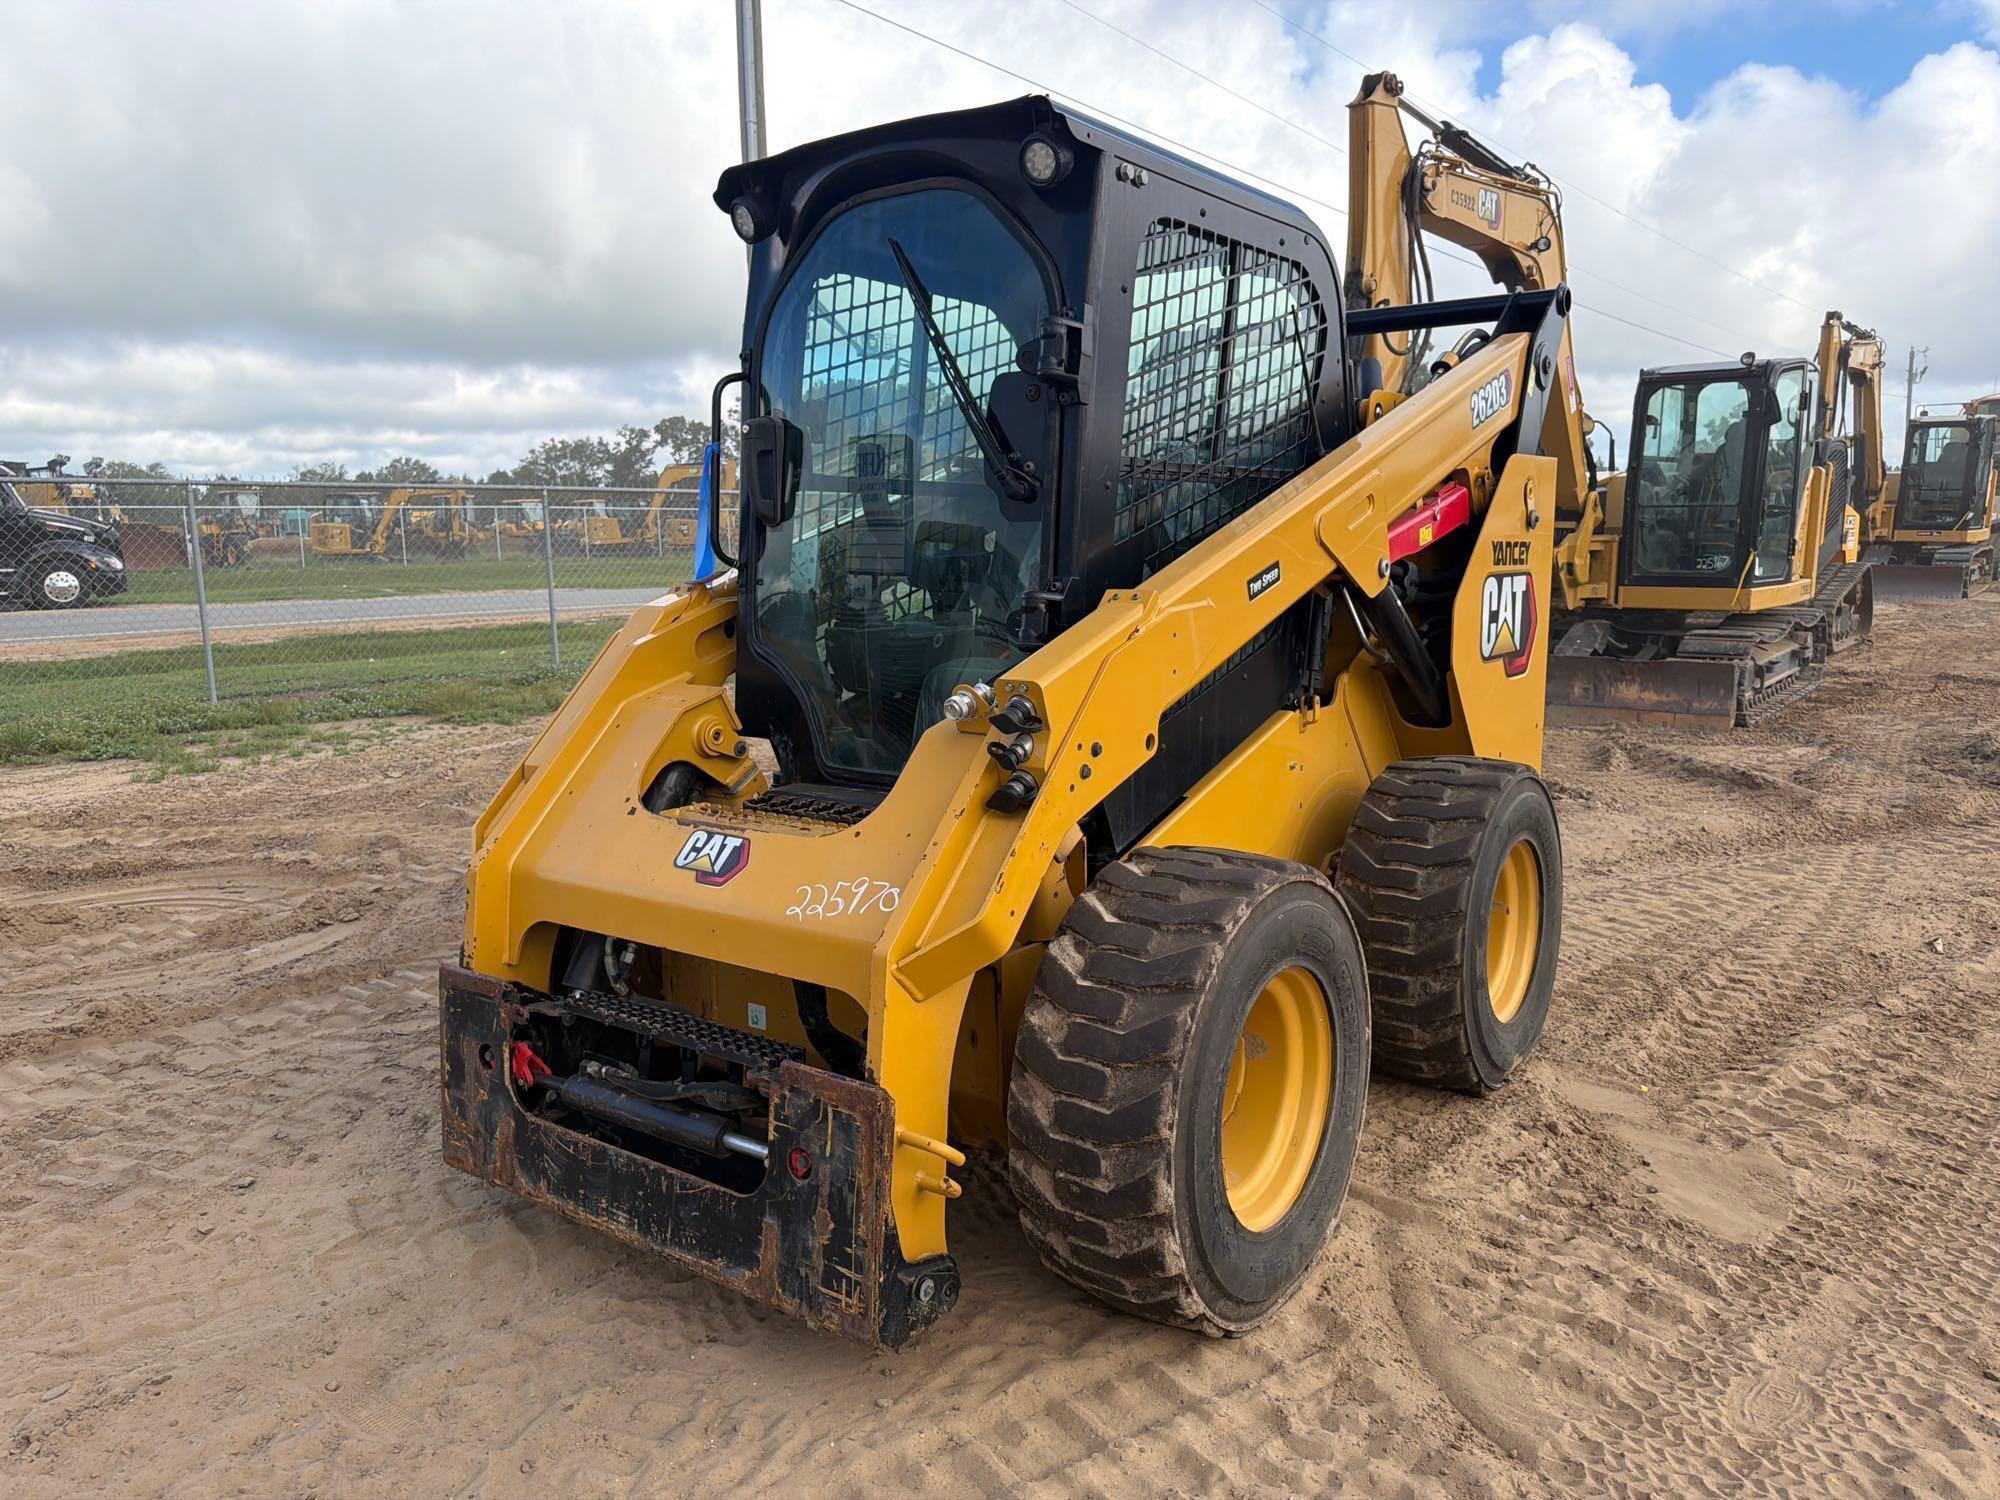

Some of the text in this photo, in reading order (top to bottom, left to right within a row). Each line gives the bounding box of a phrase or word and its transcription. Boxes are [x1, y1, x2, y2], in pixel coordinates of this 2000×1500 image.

[1478, 188, 1498, 223] CAT
[1471, 374, 1507, 428] 262D3
[1492, 541, 1531, 566] YANCEY
[1481, 575, 1527, 658] CAT
[675, 830, 744, 874] CAT
[786, 877, 900, 922] 225970
